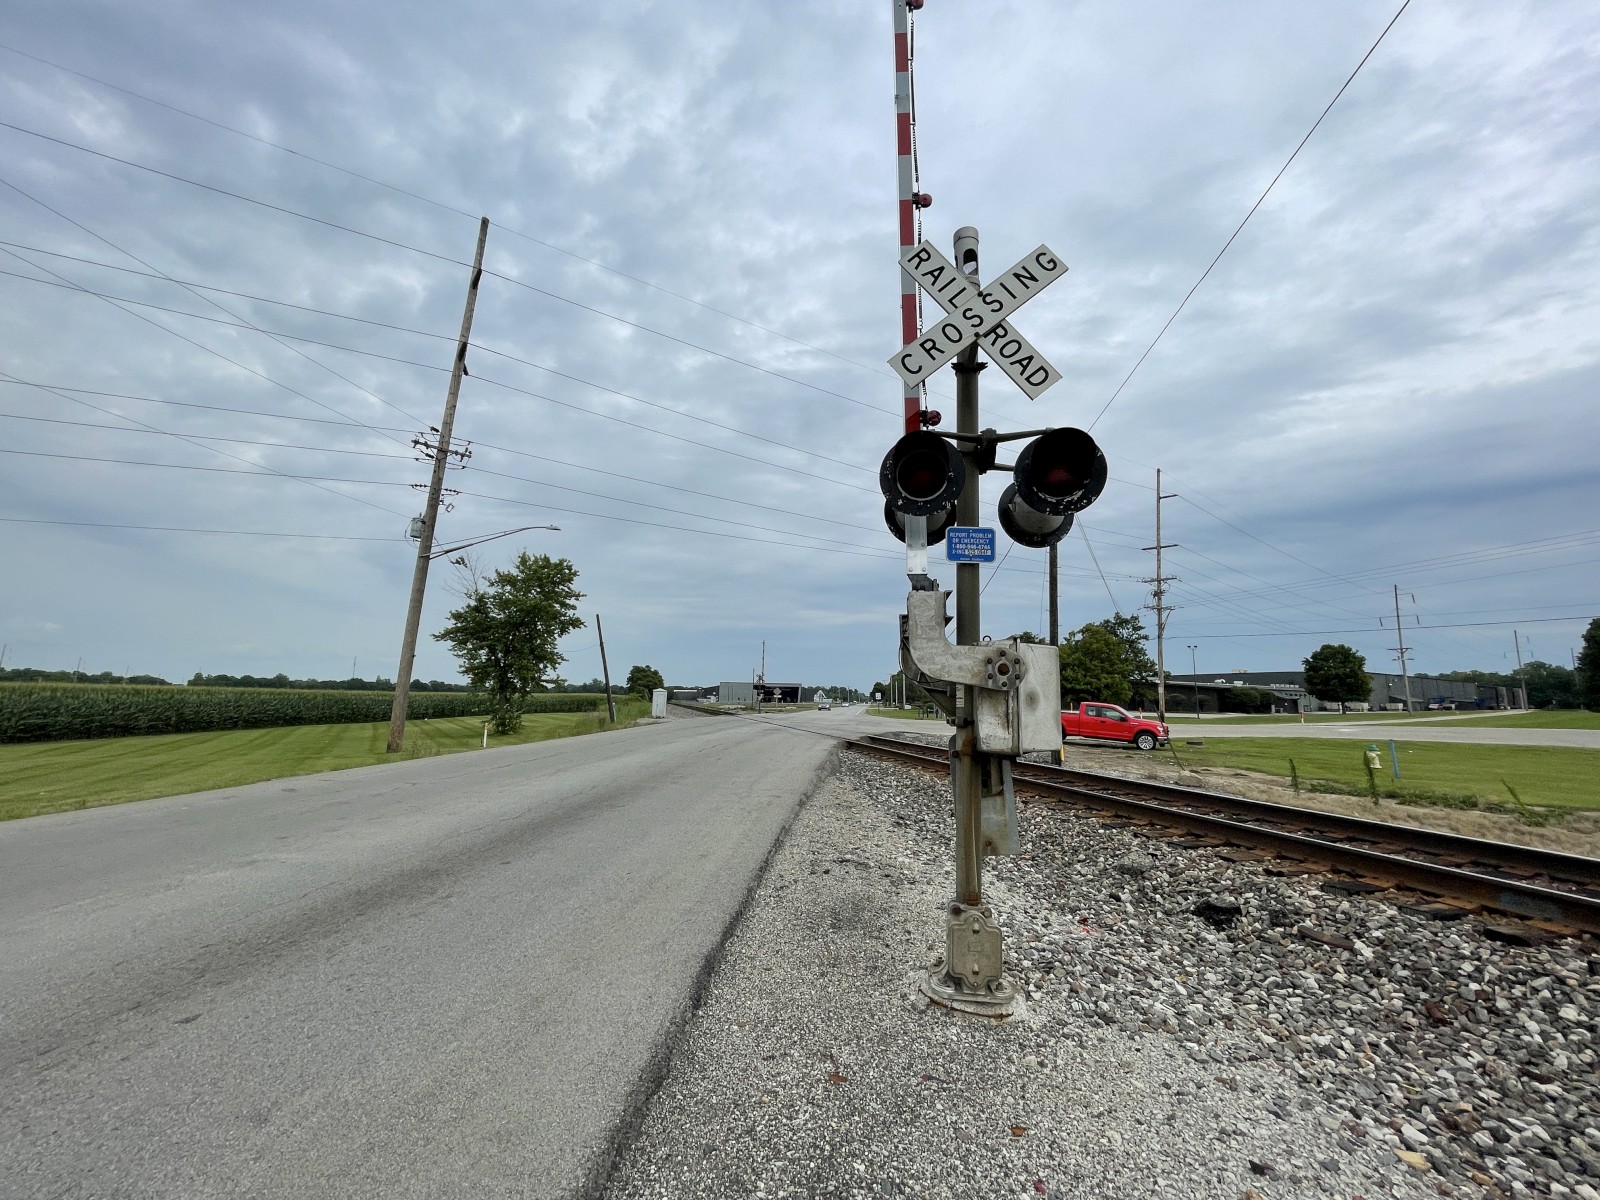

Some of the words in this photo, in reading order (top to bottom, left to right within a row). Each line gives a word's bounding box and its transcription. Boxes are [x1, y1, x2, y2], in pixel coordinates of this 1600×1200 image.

[900, 252, 1058, 375] CROSSING
[907, 247, 967, 309] RAIL
[983, 324, 1049, 387] ROAD
